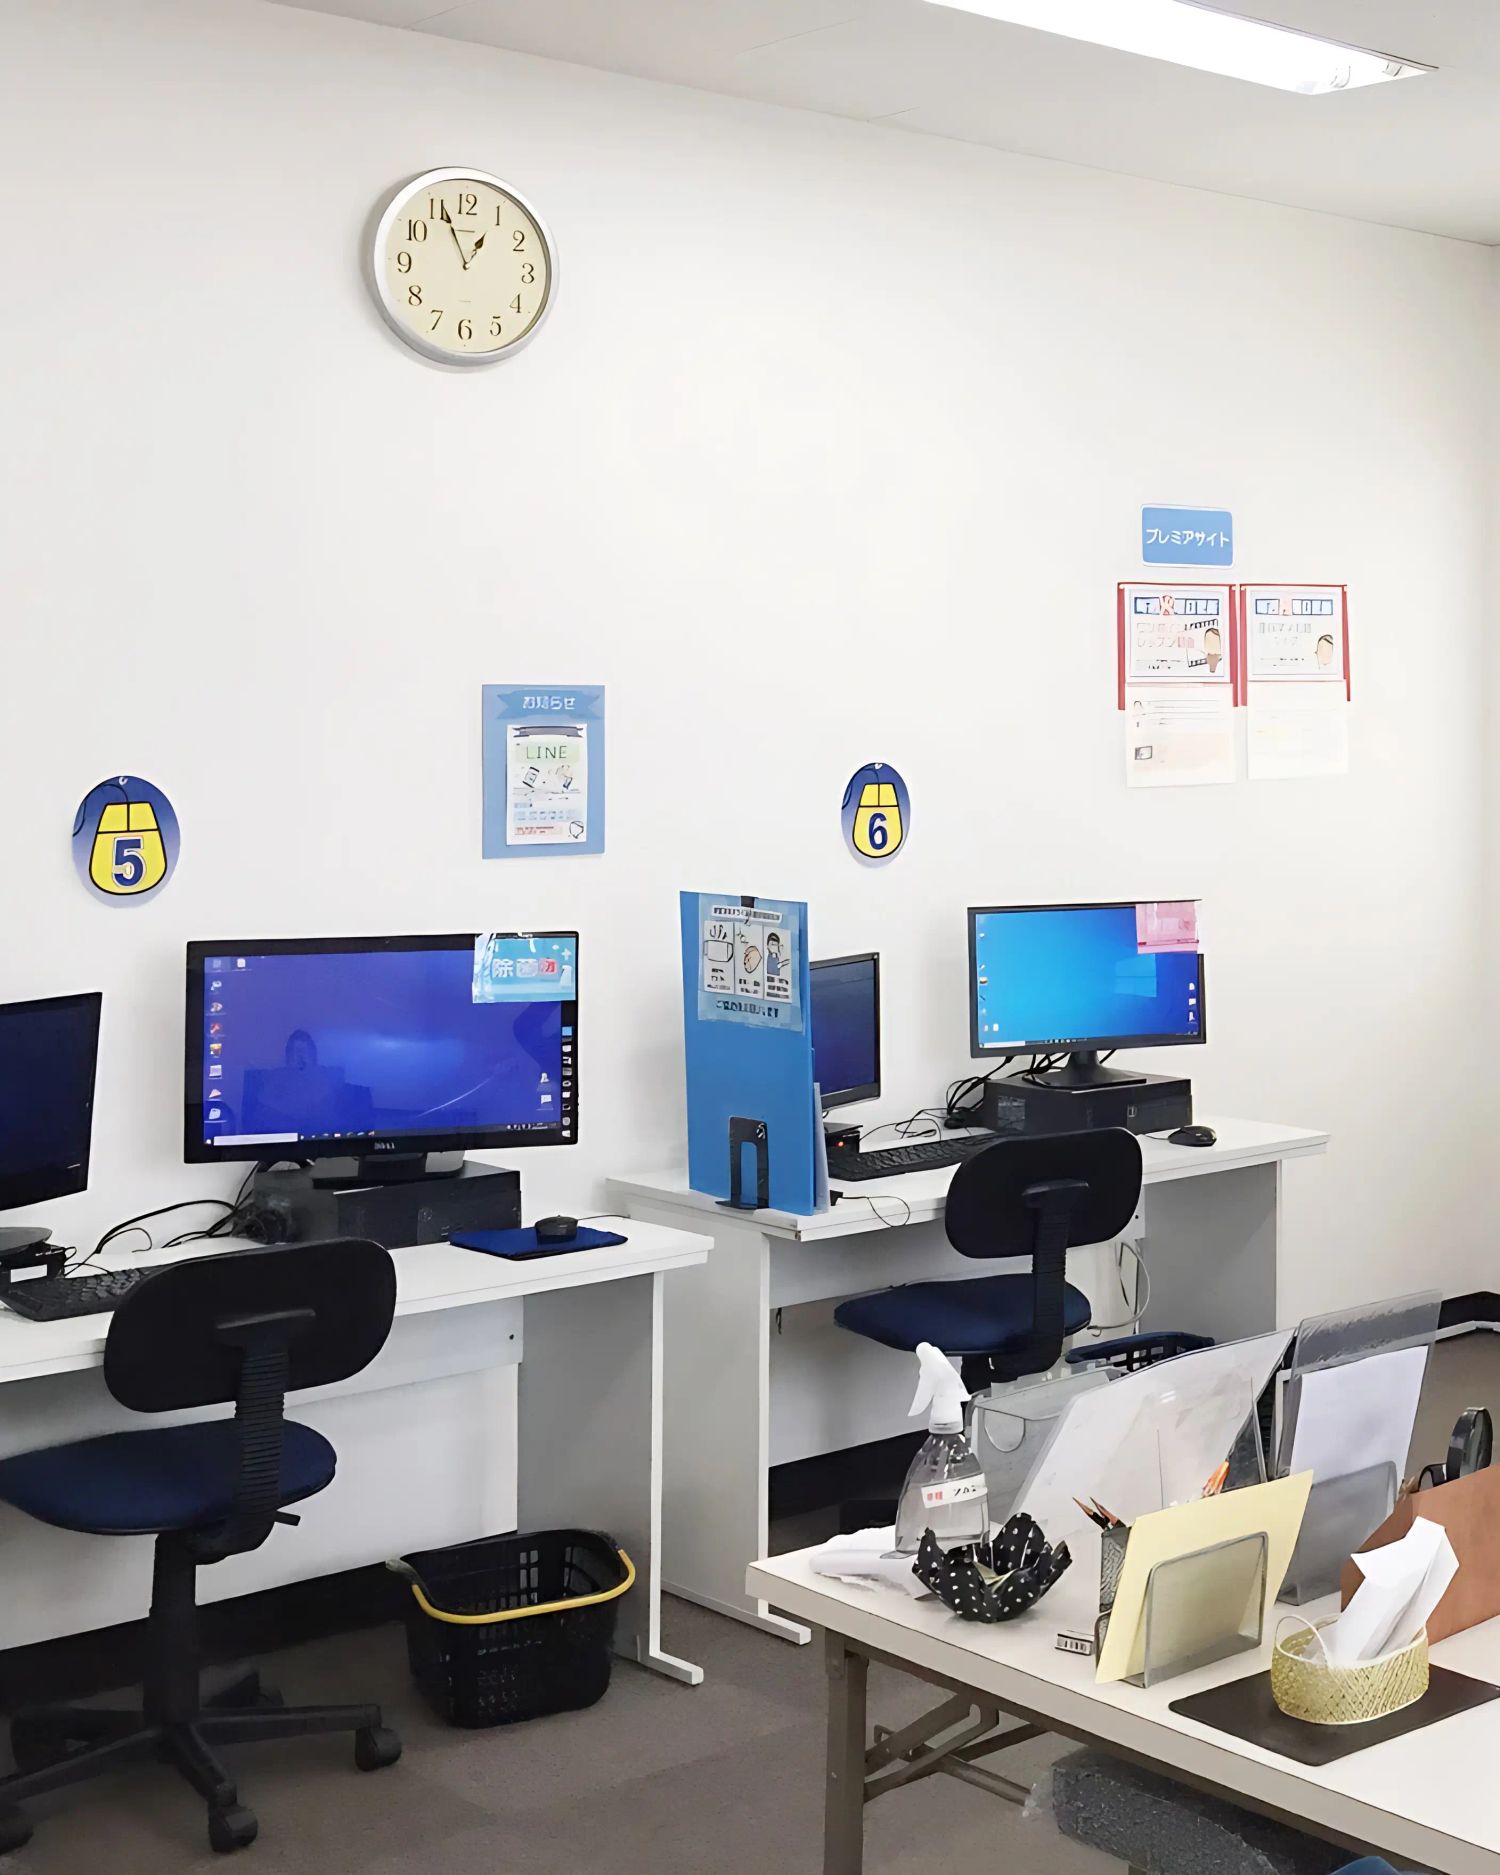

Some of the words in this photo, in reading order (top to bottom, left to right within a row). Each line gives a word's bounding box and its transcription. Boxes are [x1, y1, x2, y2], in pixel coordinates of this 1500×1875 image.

[429, 198, 445, 220] 11
[457, 193, 478, 215] 12
[495, 205, 501, 226] 1
[406, 219, 428, 242] 10
[512, 230, 525, 252] 2
[397, 252, 412, 273] 9
[521, 263, 535, 284] 3
[408, 285, 423, 306] 8
[509, 293, 522, 314] 4
[430, 309, 444, 331] 7
[457, 319, 473, 340] 6
[489, 316, 502, 336] 5
[1146, 528, 1230, 548] プレミアサイト
[526, 745, 568, 760] LINE
[868, 812, 888, 851] 6
[113, 837, 146, 887] 5
